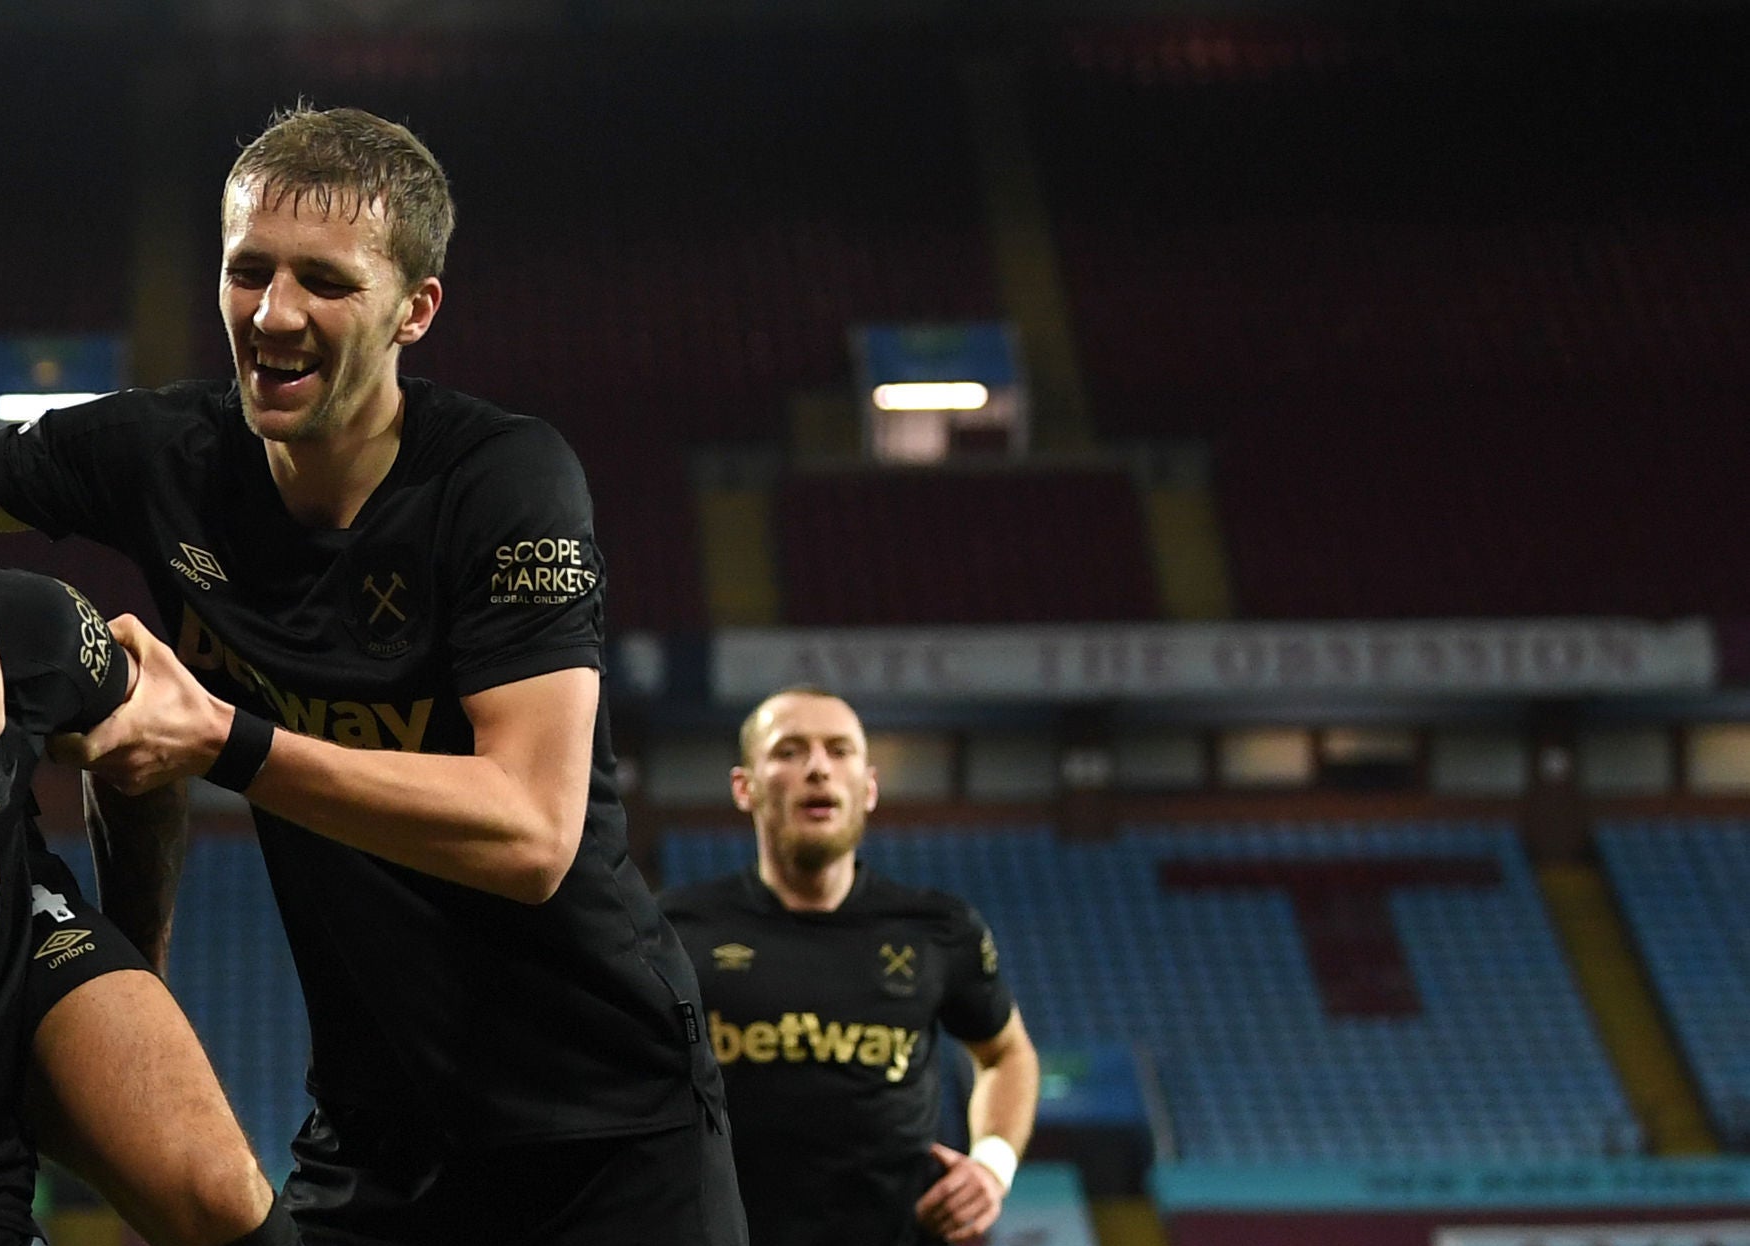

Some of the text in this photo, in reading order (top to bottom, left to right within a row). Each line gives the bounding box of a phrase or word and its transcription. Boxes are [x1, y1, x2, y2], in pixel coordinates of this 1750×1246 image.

[495, 538, 582, 569] SCOPE
[169, 557, 211, 591] umbro
[491, 566, 596, 593] MARKETS
[64, 585, 96, 669] SCOP
[47, 942, 96, 969] umbro
[709, 1011, 919, 1083] betway
